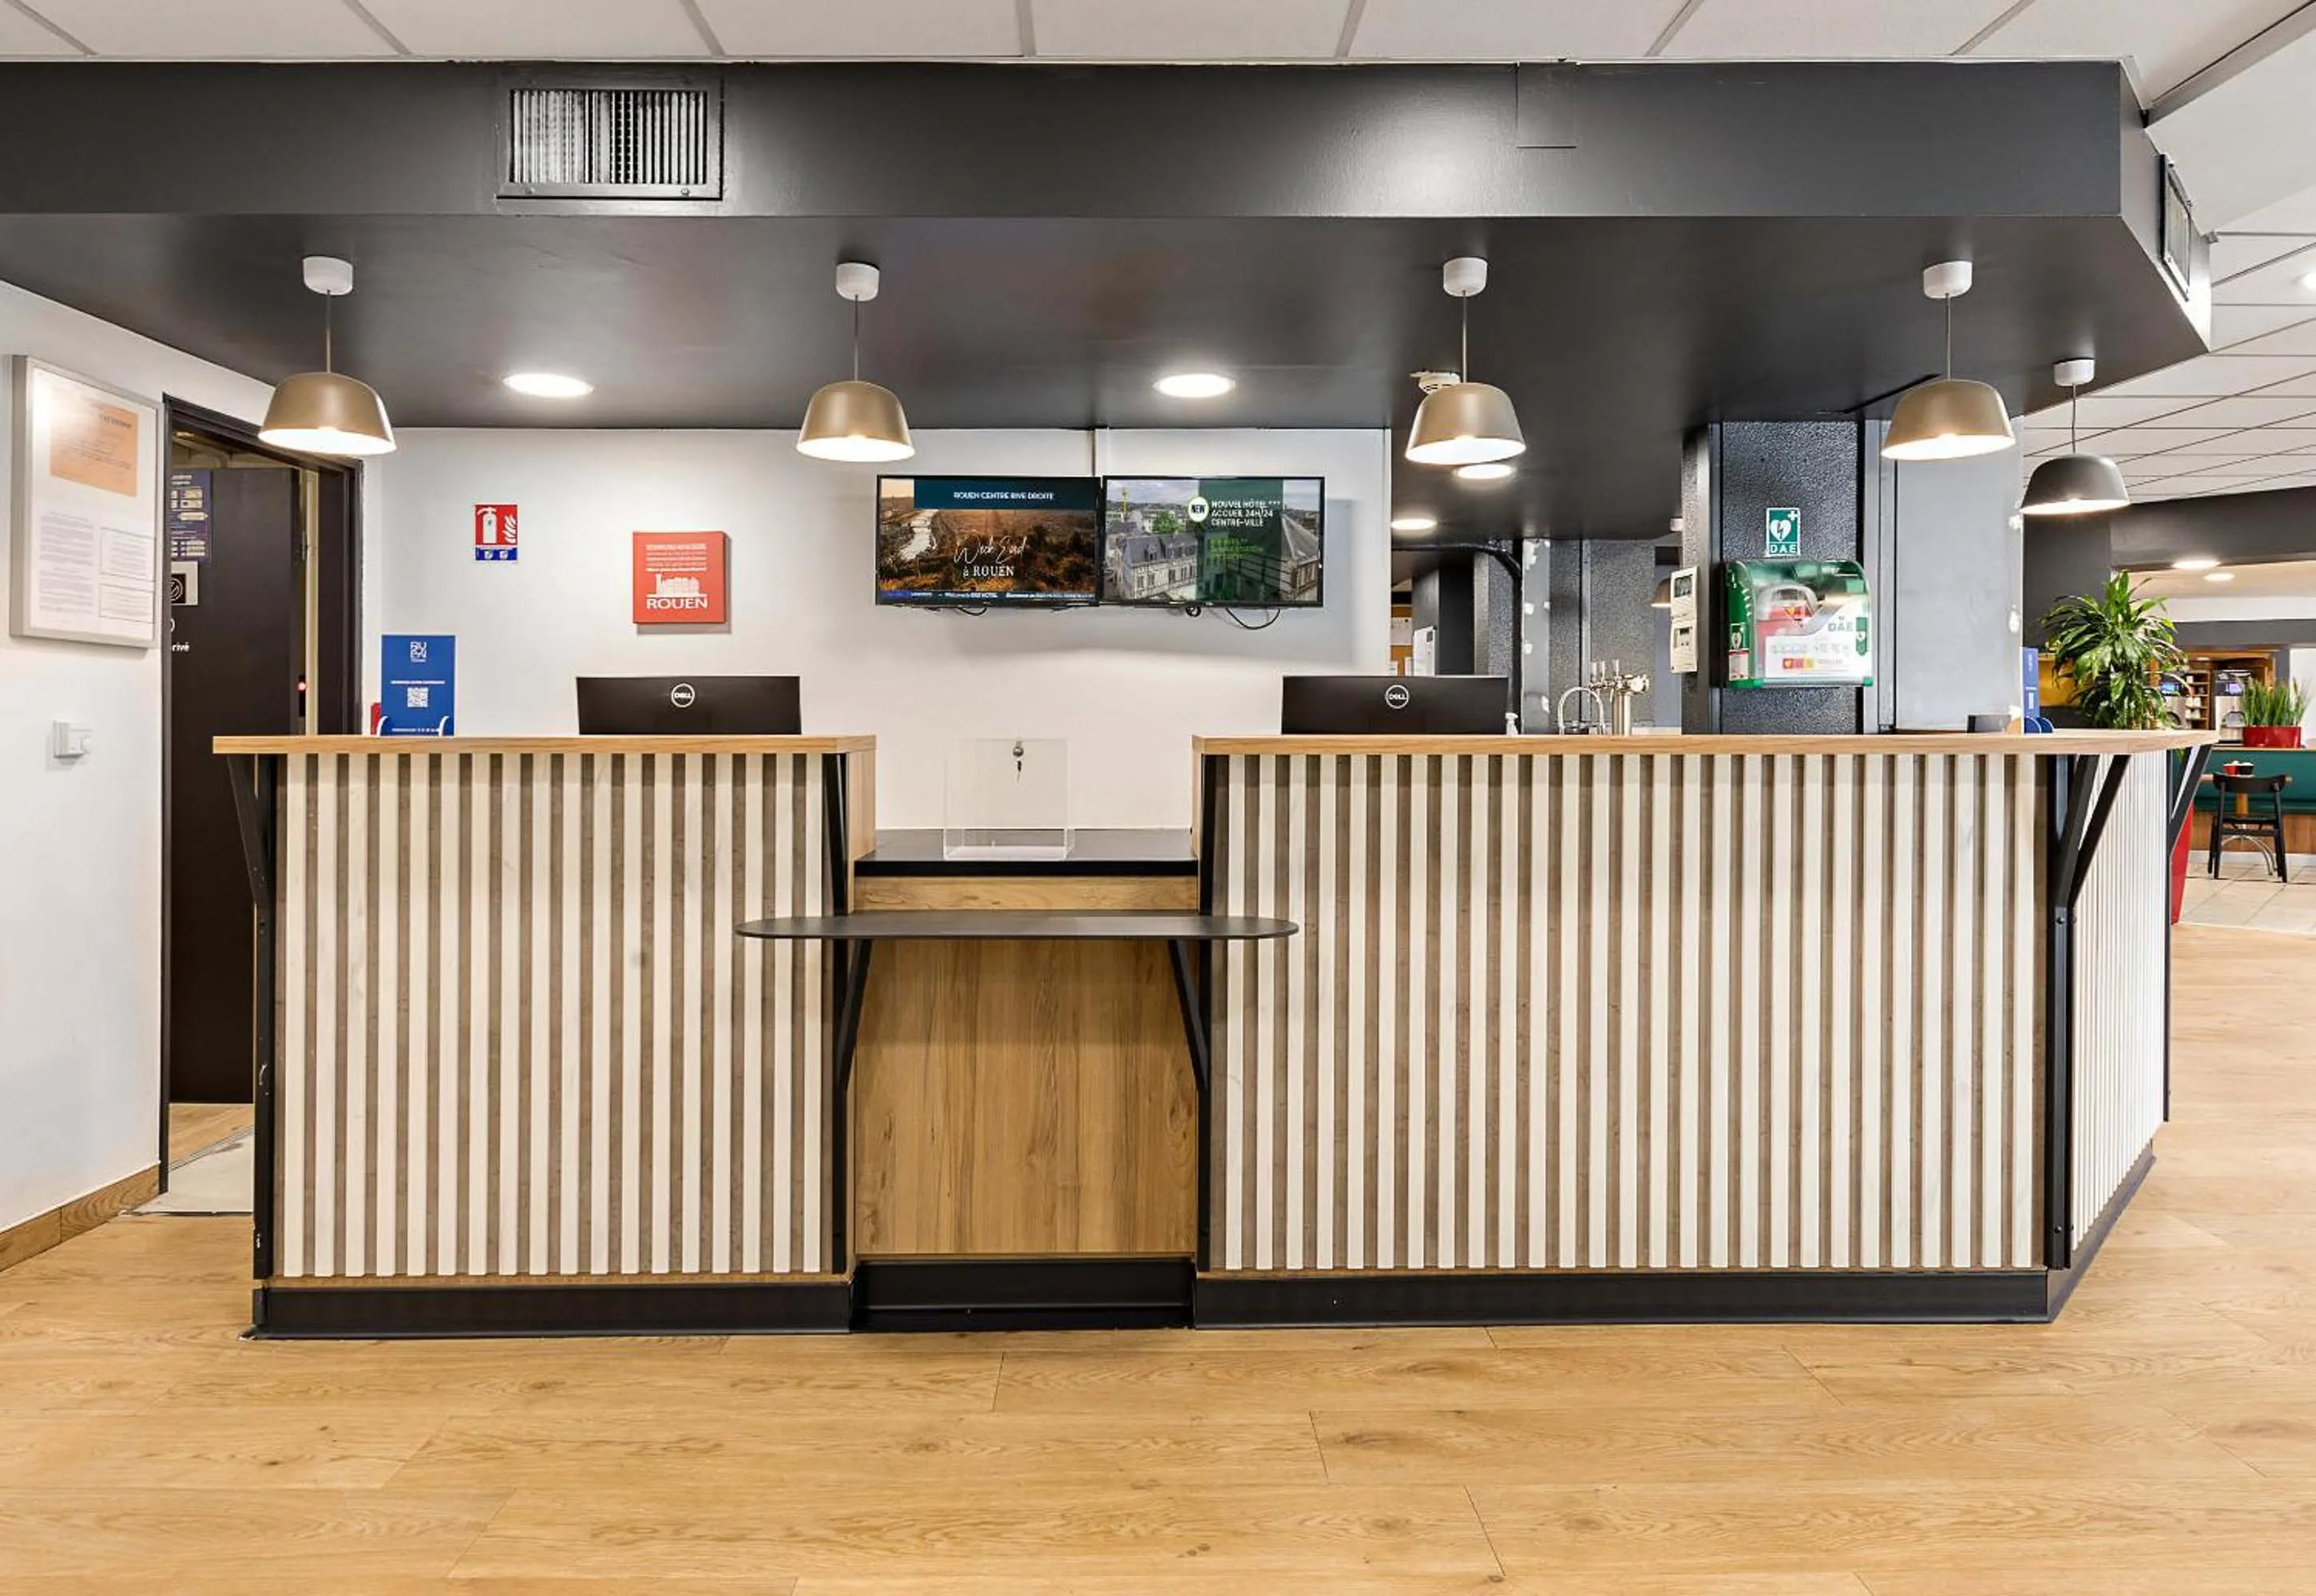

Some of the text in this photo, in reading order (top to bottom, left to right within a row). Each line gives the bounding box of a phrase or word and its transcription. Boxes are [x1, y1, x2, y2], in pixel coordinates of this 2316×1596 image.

[954, 491, 1054, 500] ROUEN CENTRE RIVE DROITE
[1212, 497, 1268, 509] NOUVEL HÔTEL
[1191, 504, 1206, 513] NEW
[1212, 509, 1274, 518] ACCUEIL 24H/24
[1212, 517, 1264, 527] CENTRE-VILLE
[1770, 544, 1797, 553] DAE
[974, 565, 1014, 576] ROUEN
[645, 597, 708, 609] ROUEN
[1827, 622, 1853, 632] DAE
[171, 641, 190, 652] rivé
